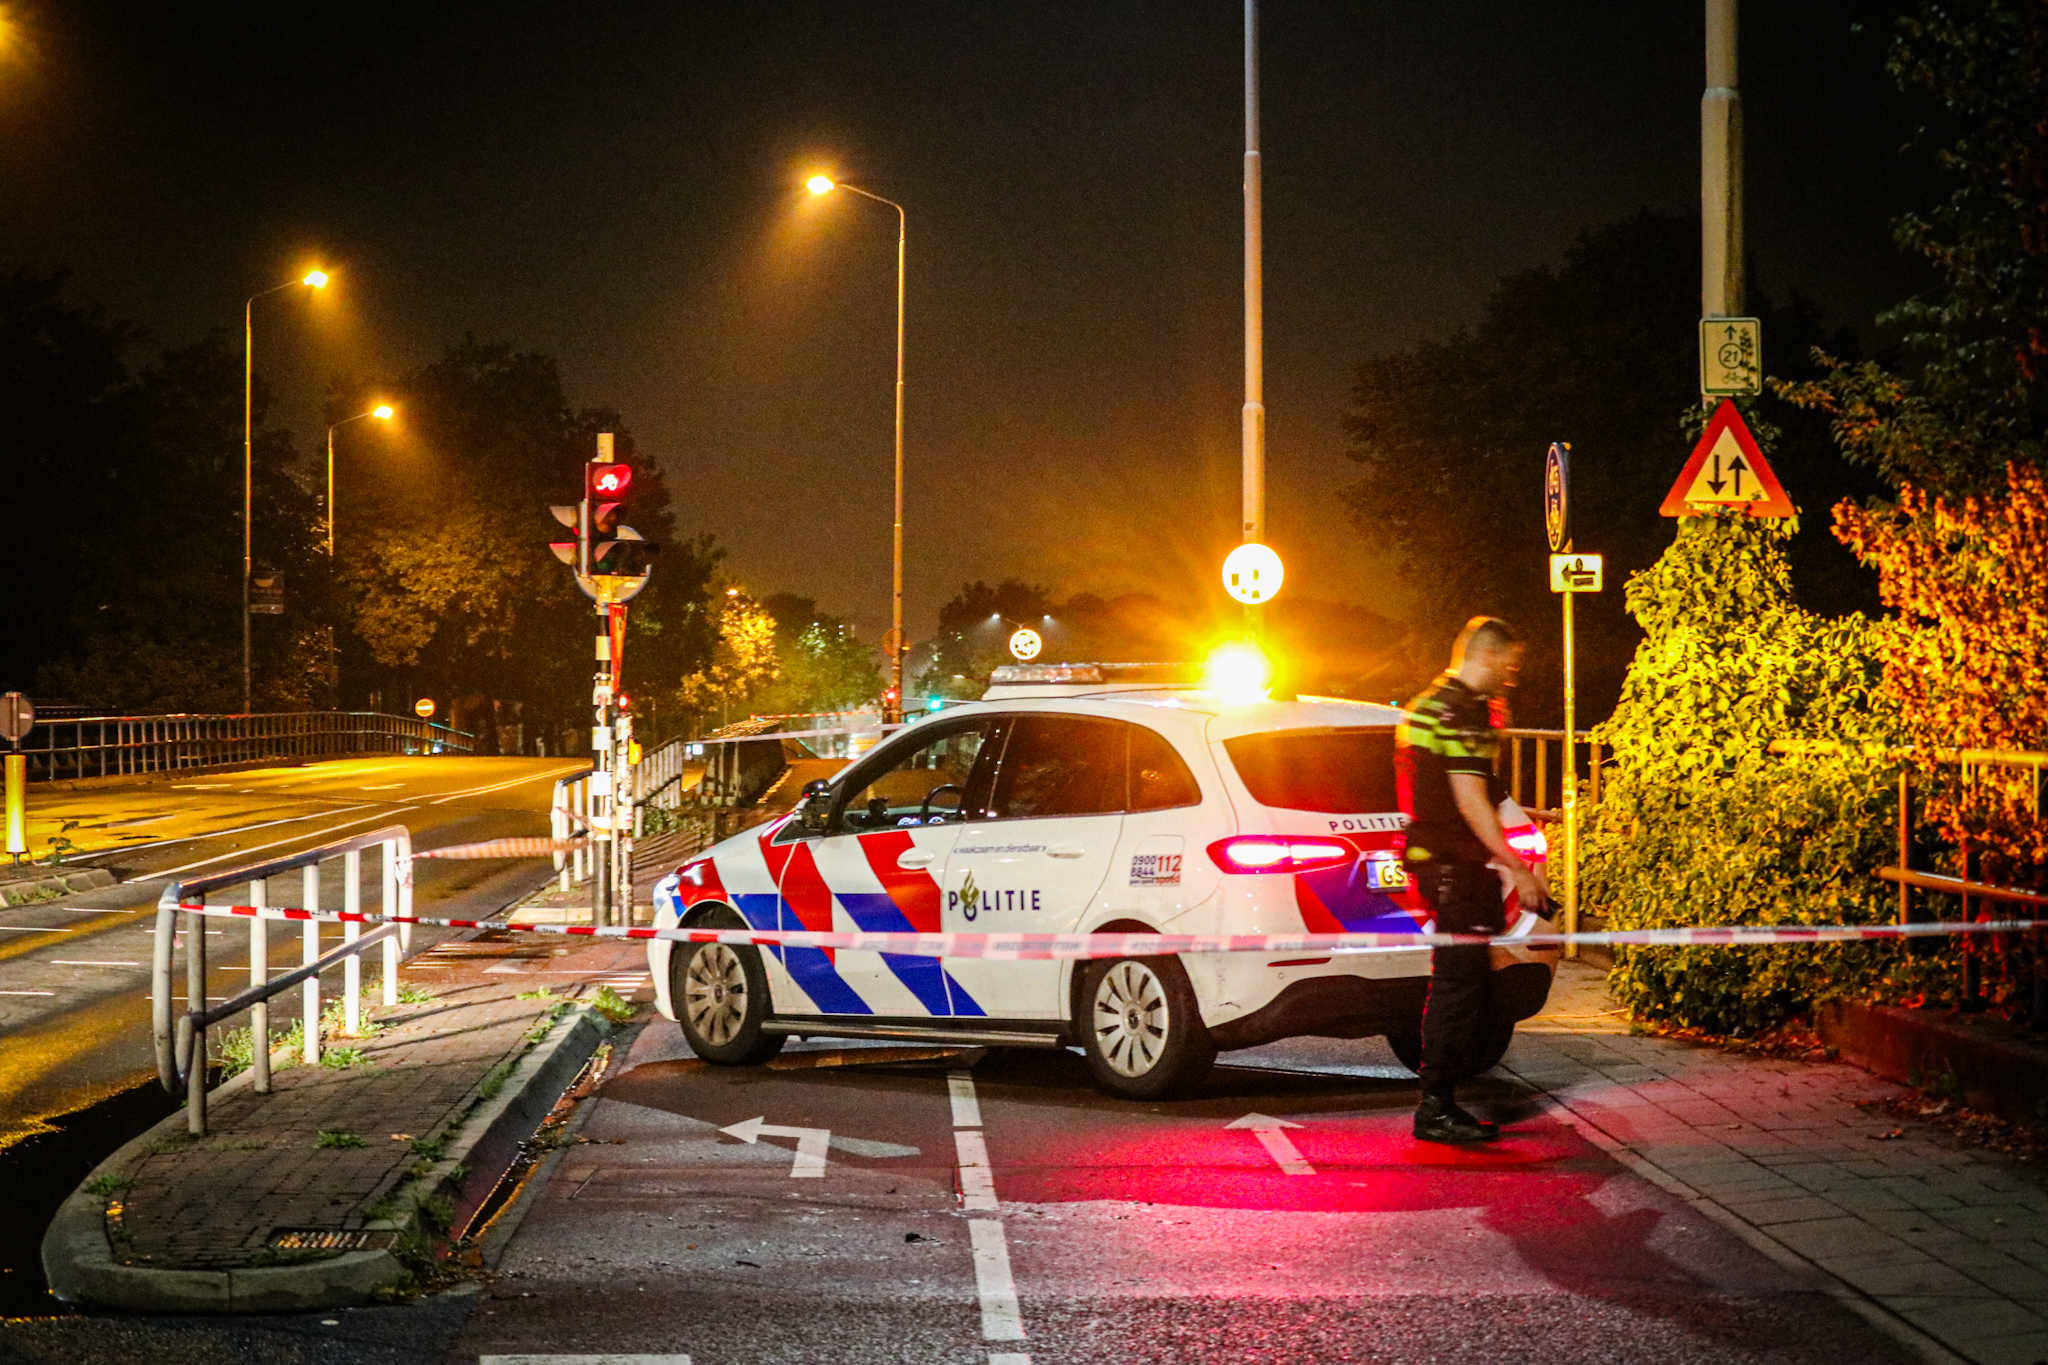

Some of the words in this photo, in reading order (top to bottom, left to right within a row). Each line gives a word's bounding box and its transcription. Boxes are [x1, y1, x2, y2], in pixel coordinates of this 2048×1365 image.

[1723, 350, 1738, 363] 21
[1328, 817, 1406, 832] POLITIE
[1132, 855, 1156, 866] 0900
[1158, 855, 1182, 872] 112
[1130, 867, 1155, 877] 8844
[948, 889, 1041, 922] POLITIE
